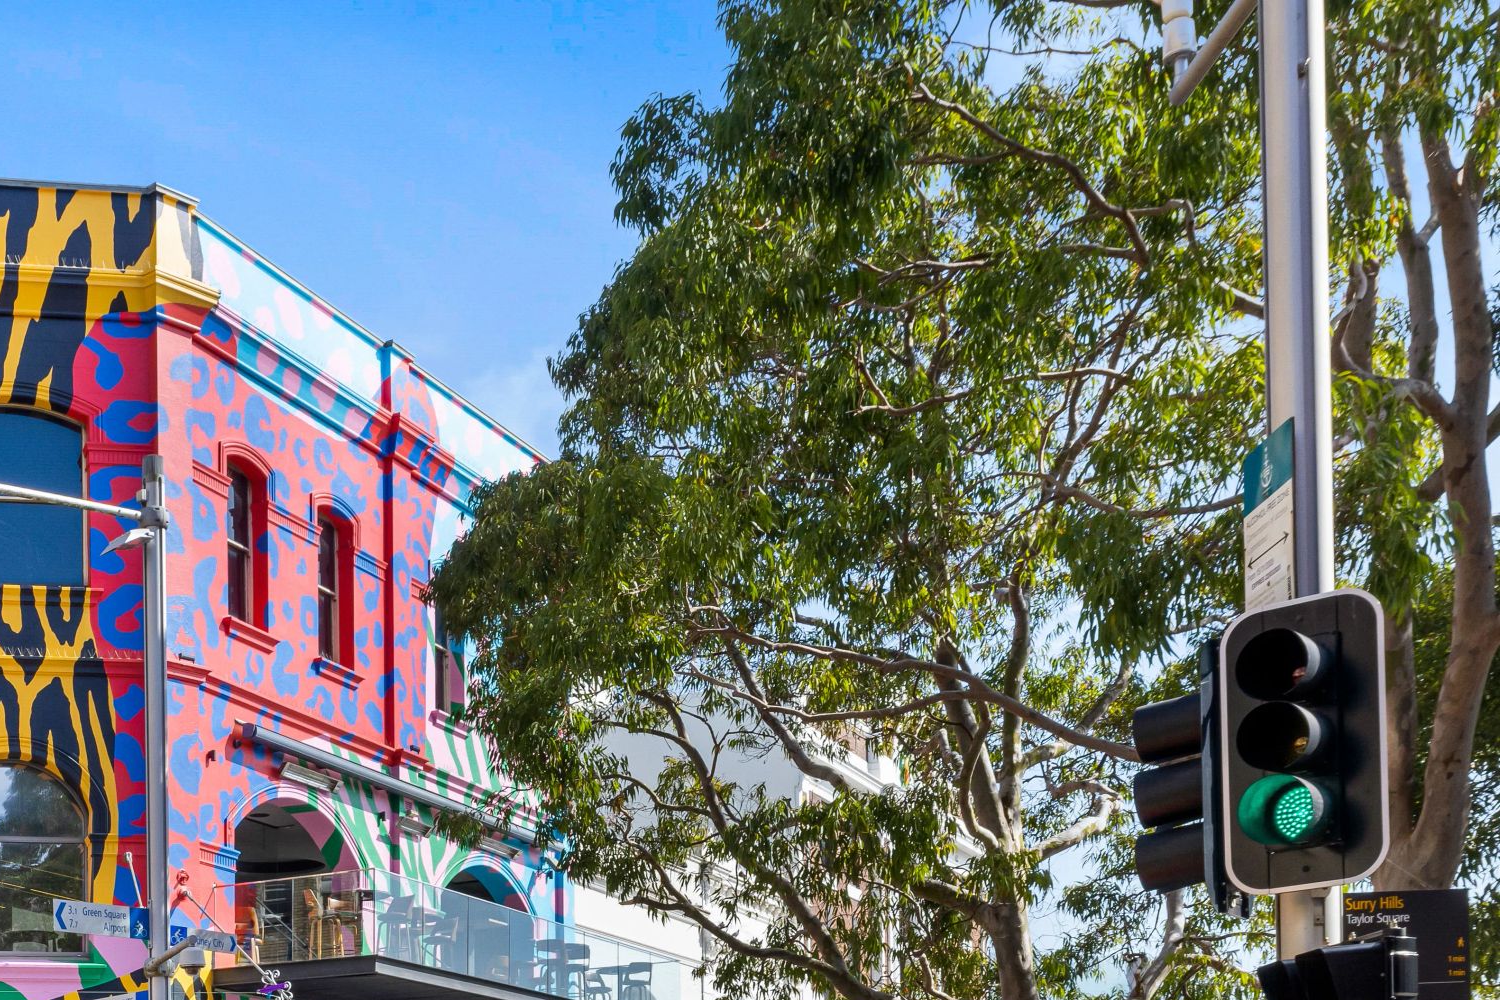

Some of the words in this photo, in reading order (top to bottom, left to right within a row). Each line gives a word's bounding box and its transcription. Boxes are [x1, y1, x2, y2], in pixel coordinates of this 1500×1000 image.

[1345, 897, 1376, 912] Surry
[1380, 895, 1404, 909] Hills
[82, 906, 102, 918] Green
[103, 908, 127, 920] Square
[1345, 913, 1375, 927] Taylor
[1376, 912, 1411, 925] Square
[103, 923, 127, 934] Airport
[213, 938, 225, 951] City
